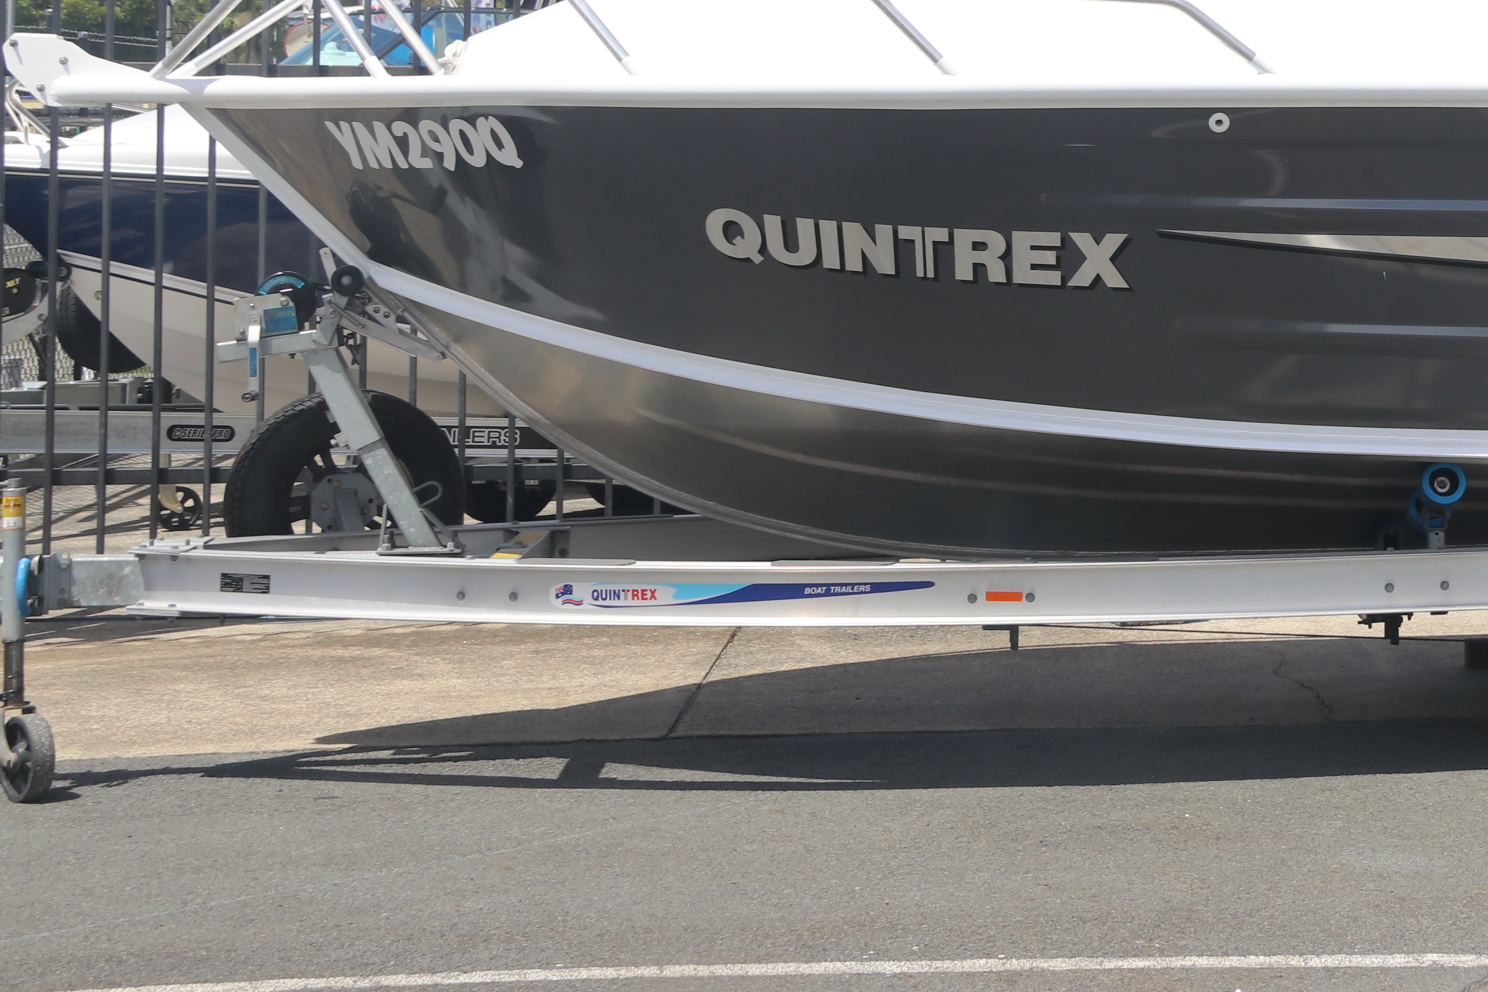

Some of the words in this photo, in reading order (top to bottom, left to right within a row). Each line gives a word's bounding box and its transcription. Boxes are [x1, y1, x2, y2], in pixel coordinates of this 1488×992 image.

[324, 115, 524, 171] YM290Q
[705, 208, 1130, 289] QUINTREX
[181, 428, 206, 438] SERIE
[212, 429, 231, 439] PRO
[591, 589, 657, 601] QUINTREX
[830, 585, 871, 593] TRAILERS
